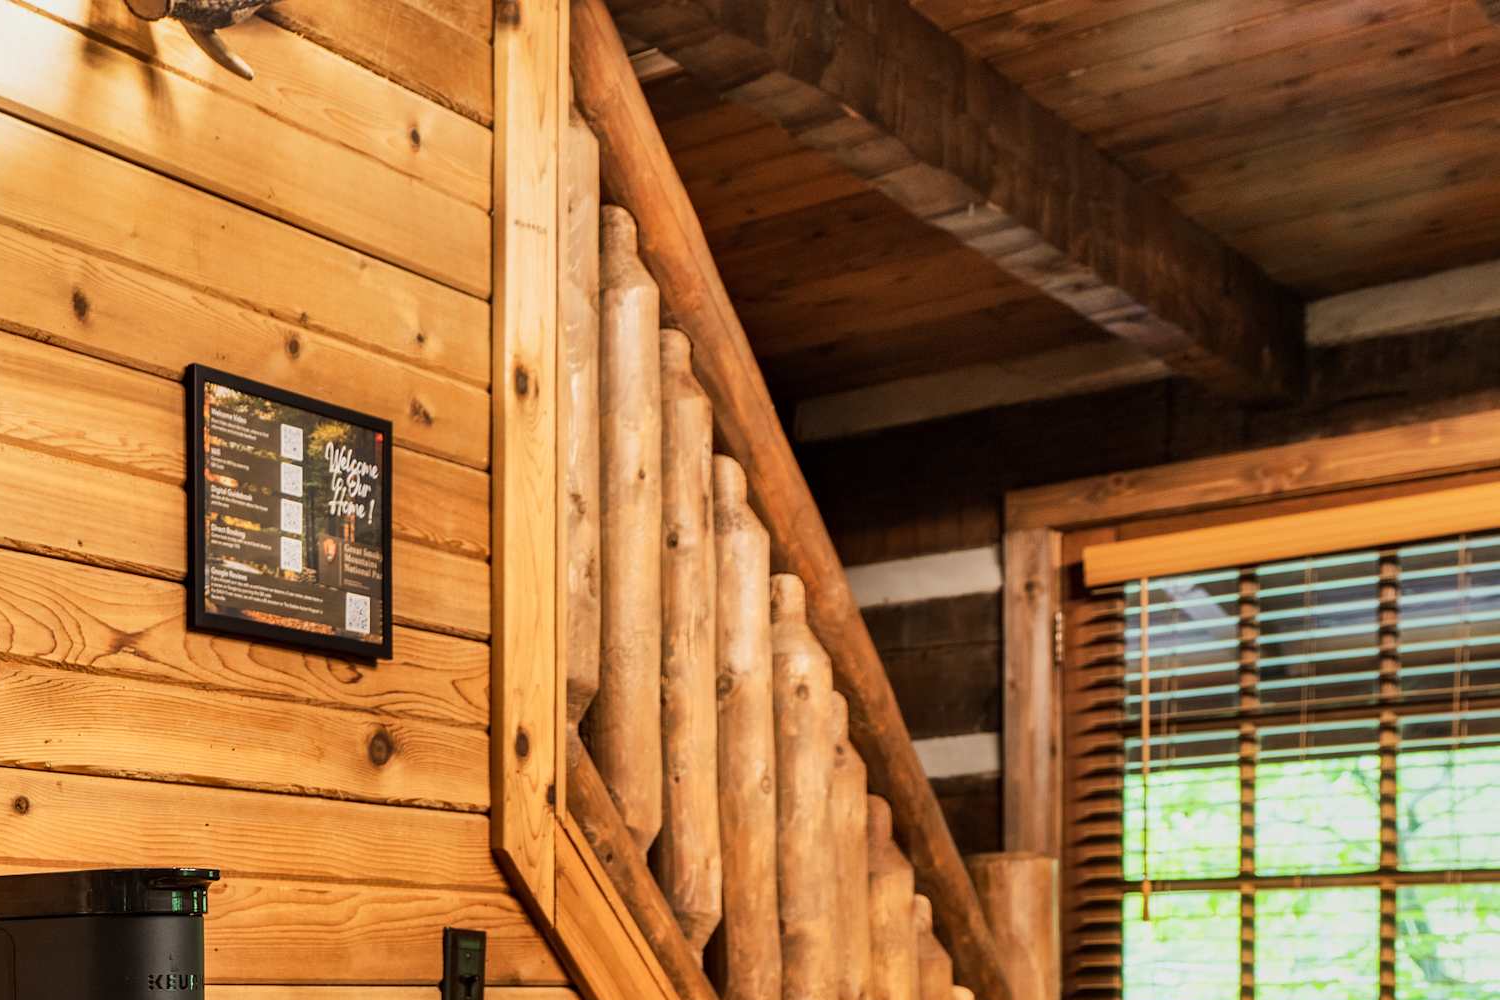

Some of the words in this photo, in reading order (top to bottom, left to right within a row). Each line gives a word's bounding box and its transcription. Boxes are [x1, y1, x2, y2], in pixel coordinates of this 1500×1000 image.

[325, 441, 380, 479] Welcome
[346, 473, 372, 498] Our
[148, 974, 203, 990] KEUR
